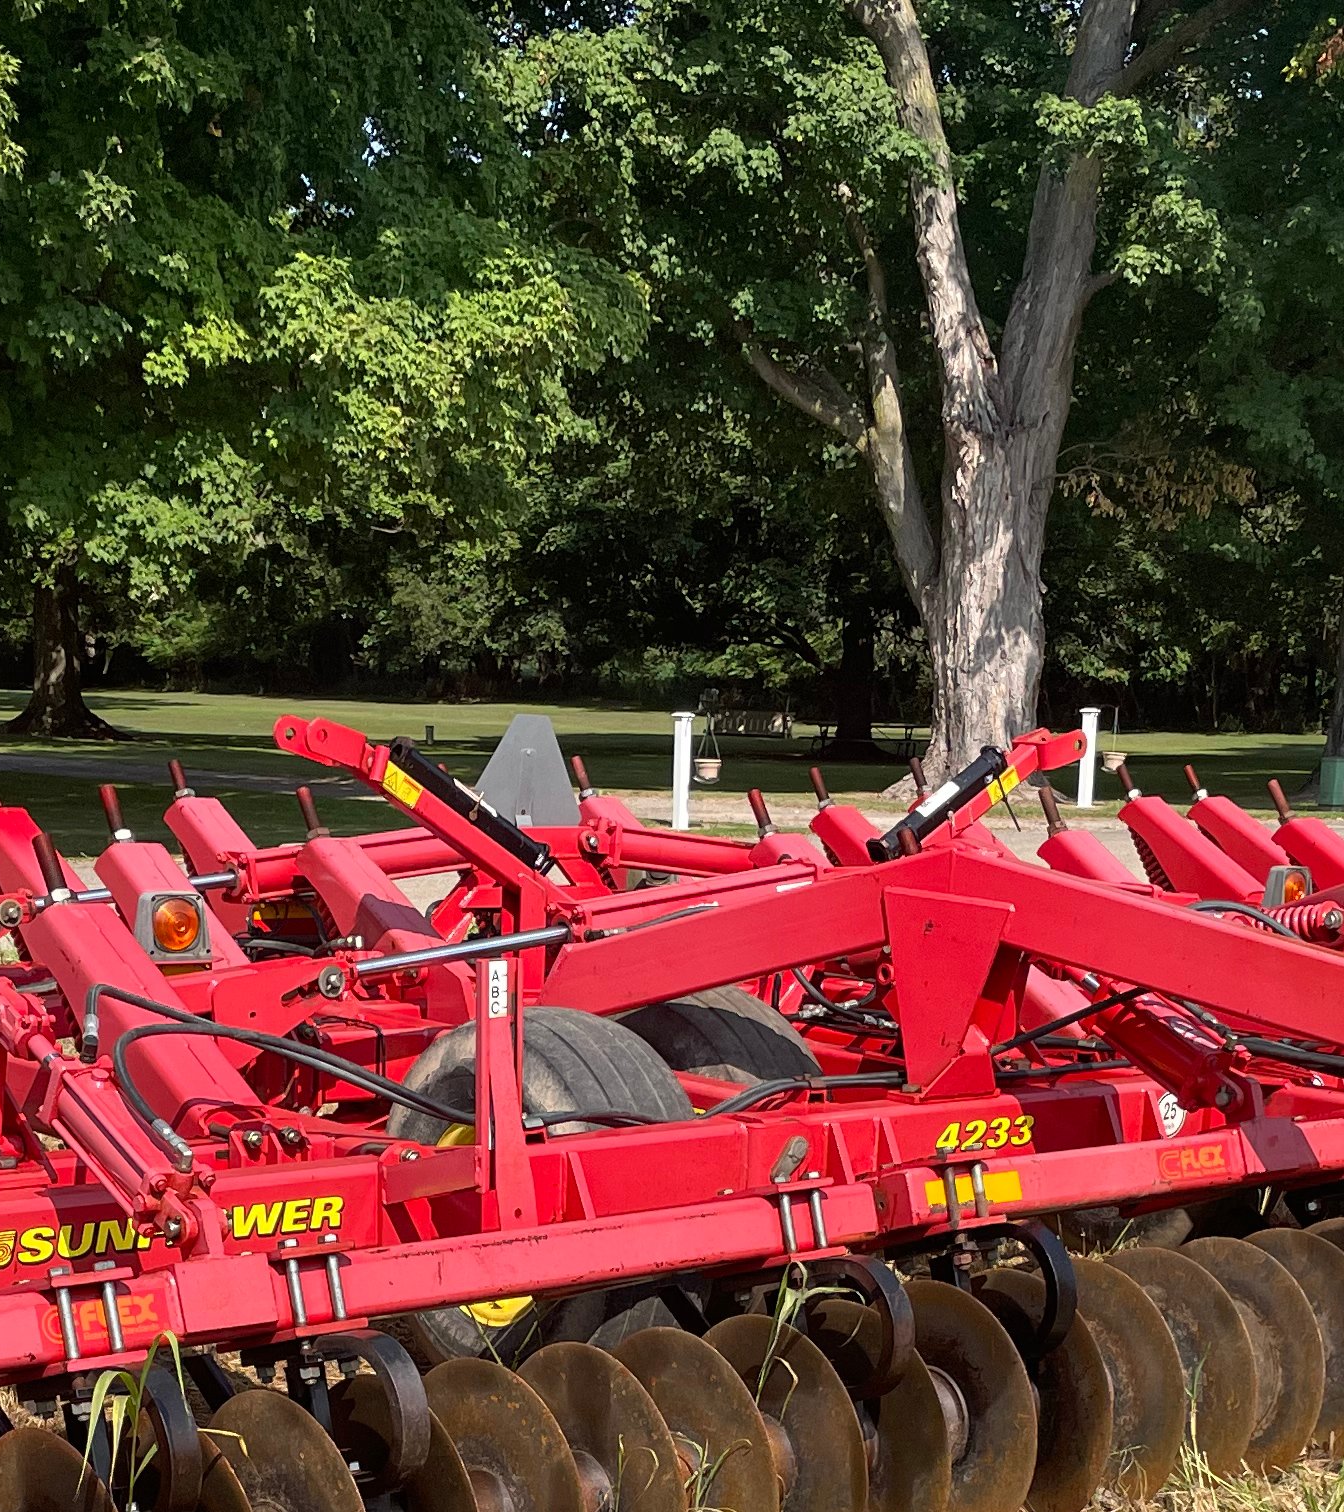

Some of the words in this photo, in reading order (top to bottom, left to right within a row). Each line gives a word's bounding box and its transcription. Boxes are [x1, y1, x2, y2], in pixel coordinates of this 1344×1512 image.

[491, 969, 500, 982] A
[491, 985, 500, 999] B
[490, 1001, 500, 1015] C
[1163, 1101, 1177, 1121] 25
[935, 1115, 1035, 1151] 4233
[16, 1196, 345, 1264] SUNWER
